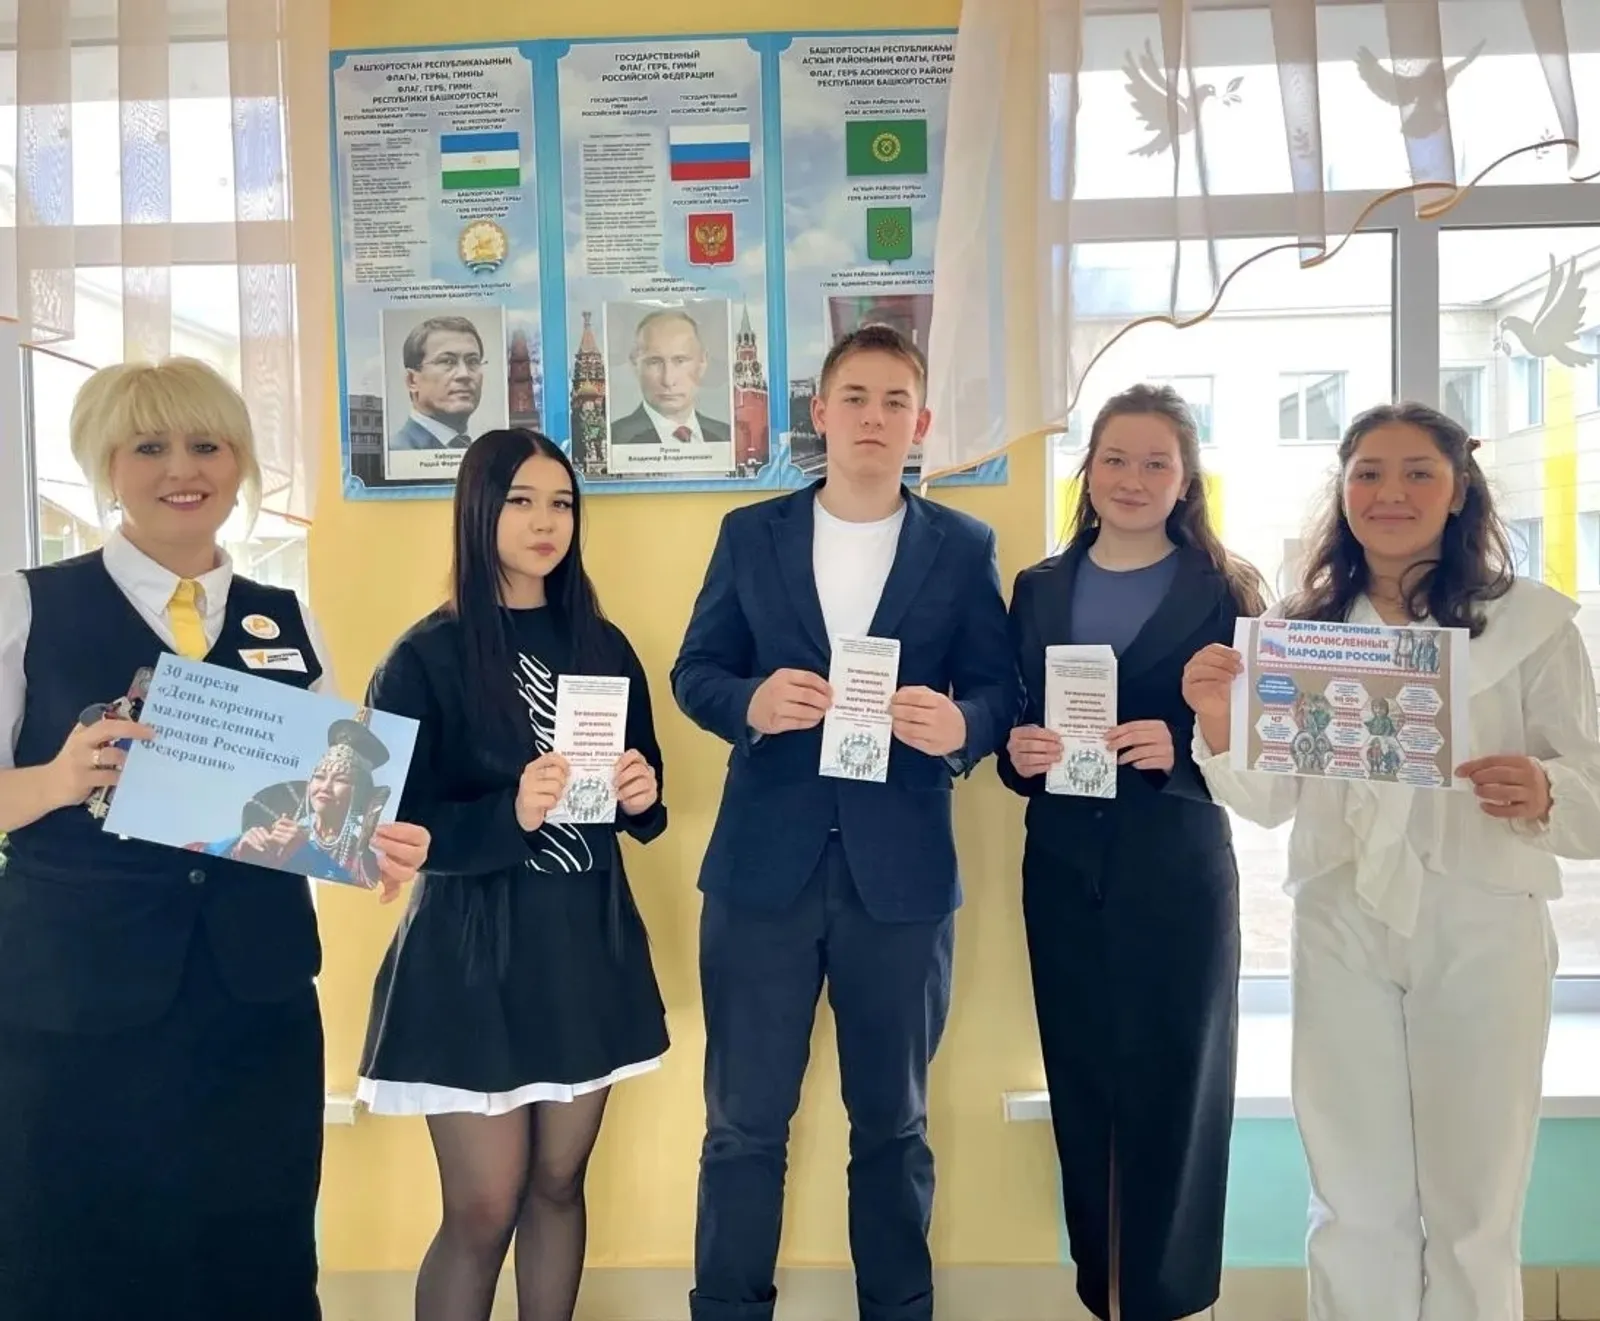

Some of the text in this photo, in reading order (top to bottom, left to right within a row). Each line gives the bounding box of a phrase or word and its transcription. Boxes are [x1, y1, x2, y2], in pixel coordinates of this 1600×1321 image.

[615, 50, 700, 62] ГОСУДАРСТВЕННЫЙ
[672, 62, 697, 70] ГИМН
[837, 69, 859, 77] ГЕРБ
[860, 67, 917, 77] АСКИНСКОГО
[452, 70, 484, 79] ГИМНЫ
[602, 71, 715, 82] РОССИЙСКОЙ ФЕДЕРАЦИИ
[448, 83, 472, 91] ГИМН
[818, 77, 947, 88] РЕСПУБЛИКИ БАШКОРТОСТАН
[372, 91, 498, 104] РЕСПУБЛИКИ БАШКОРТОСТАН
[1288, 622, 1318, 633] ДЕНЬ
[1319, 623, 1381, 636] КОРЕННЫХ
[1287, 635, 1390, 649] МАЛОЧИСЛЕННЫХ
[1287, 648, 1392, 663] НАРОДОВ РОССИИ
[163, 664, 240, 694] 30 апреля
[157, 684, 285, 725] «День коренных
[151, 702, 276, 743] малочисленных
[140, 738, 236, 772] Федерации»
[213, 735, 300, 769] Российской
